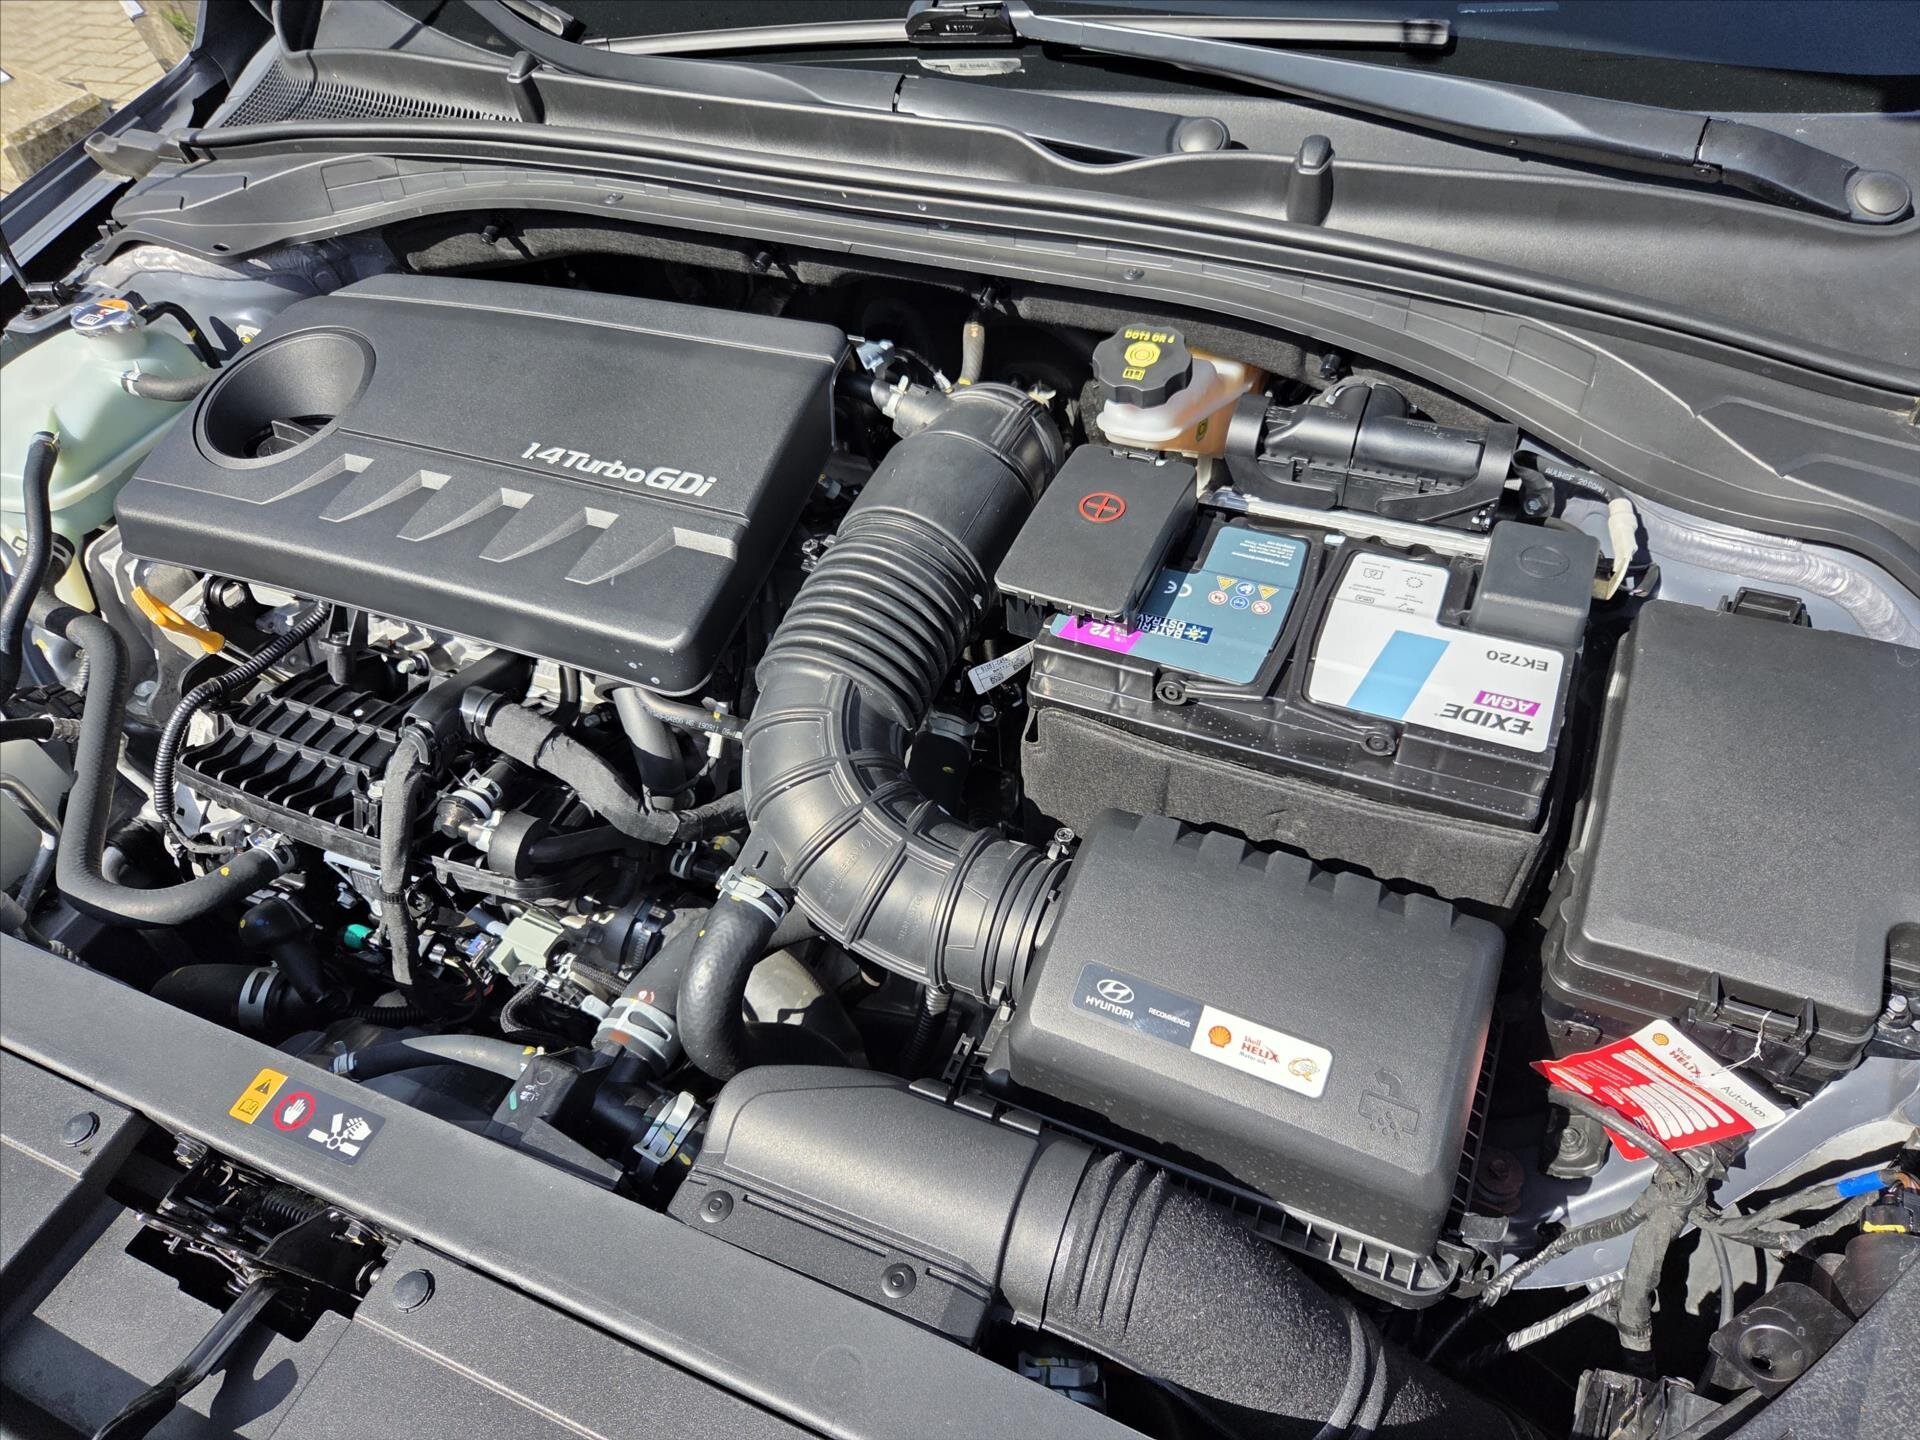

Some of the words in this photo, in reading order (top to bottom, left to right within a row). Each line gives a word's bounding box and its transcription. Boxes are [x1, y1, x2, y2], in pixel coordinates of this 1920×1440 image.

[1151, 332, 1167, 344] OR
[1089, 622, 1112, 638] 72
[1137, 614, 1187, 631] OSTRAV
[1137, 621, 1183, 640] BATERI
[1486, 650, 1549, 672] EK720
[1481, 693, 1536, 713] AGM
[1439, 702, 1533, 736] EXIDE
[1085, 995, 1134, 1020] HYUNDAI
[1148, 1007, 1191, 1028] RECOMMENDS
[1244, 1035, 1262, 1046] Shell
[1241, 1042, 1278, 1063] HELIX
[1677, 1047, 1692, 1060] Shell
[1669, 1050, 1702, 1079] HELIX
[1720, 1086, 1768, 1119] AutoMax
